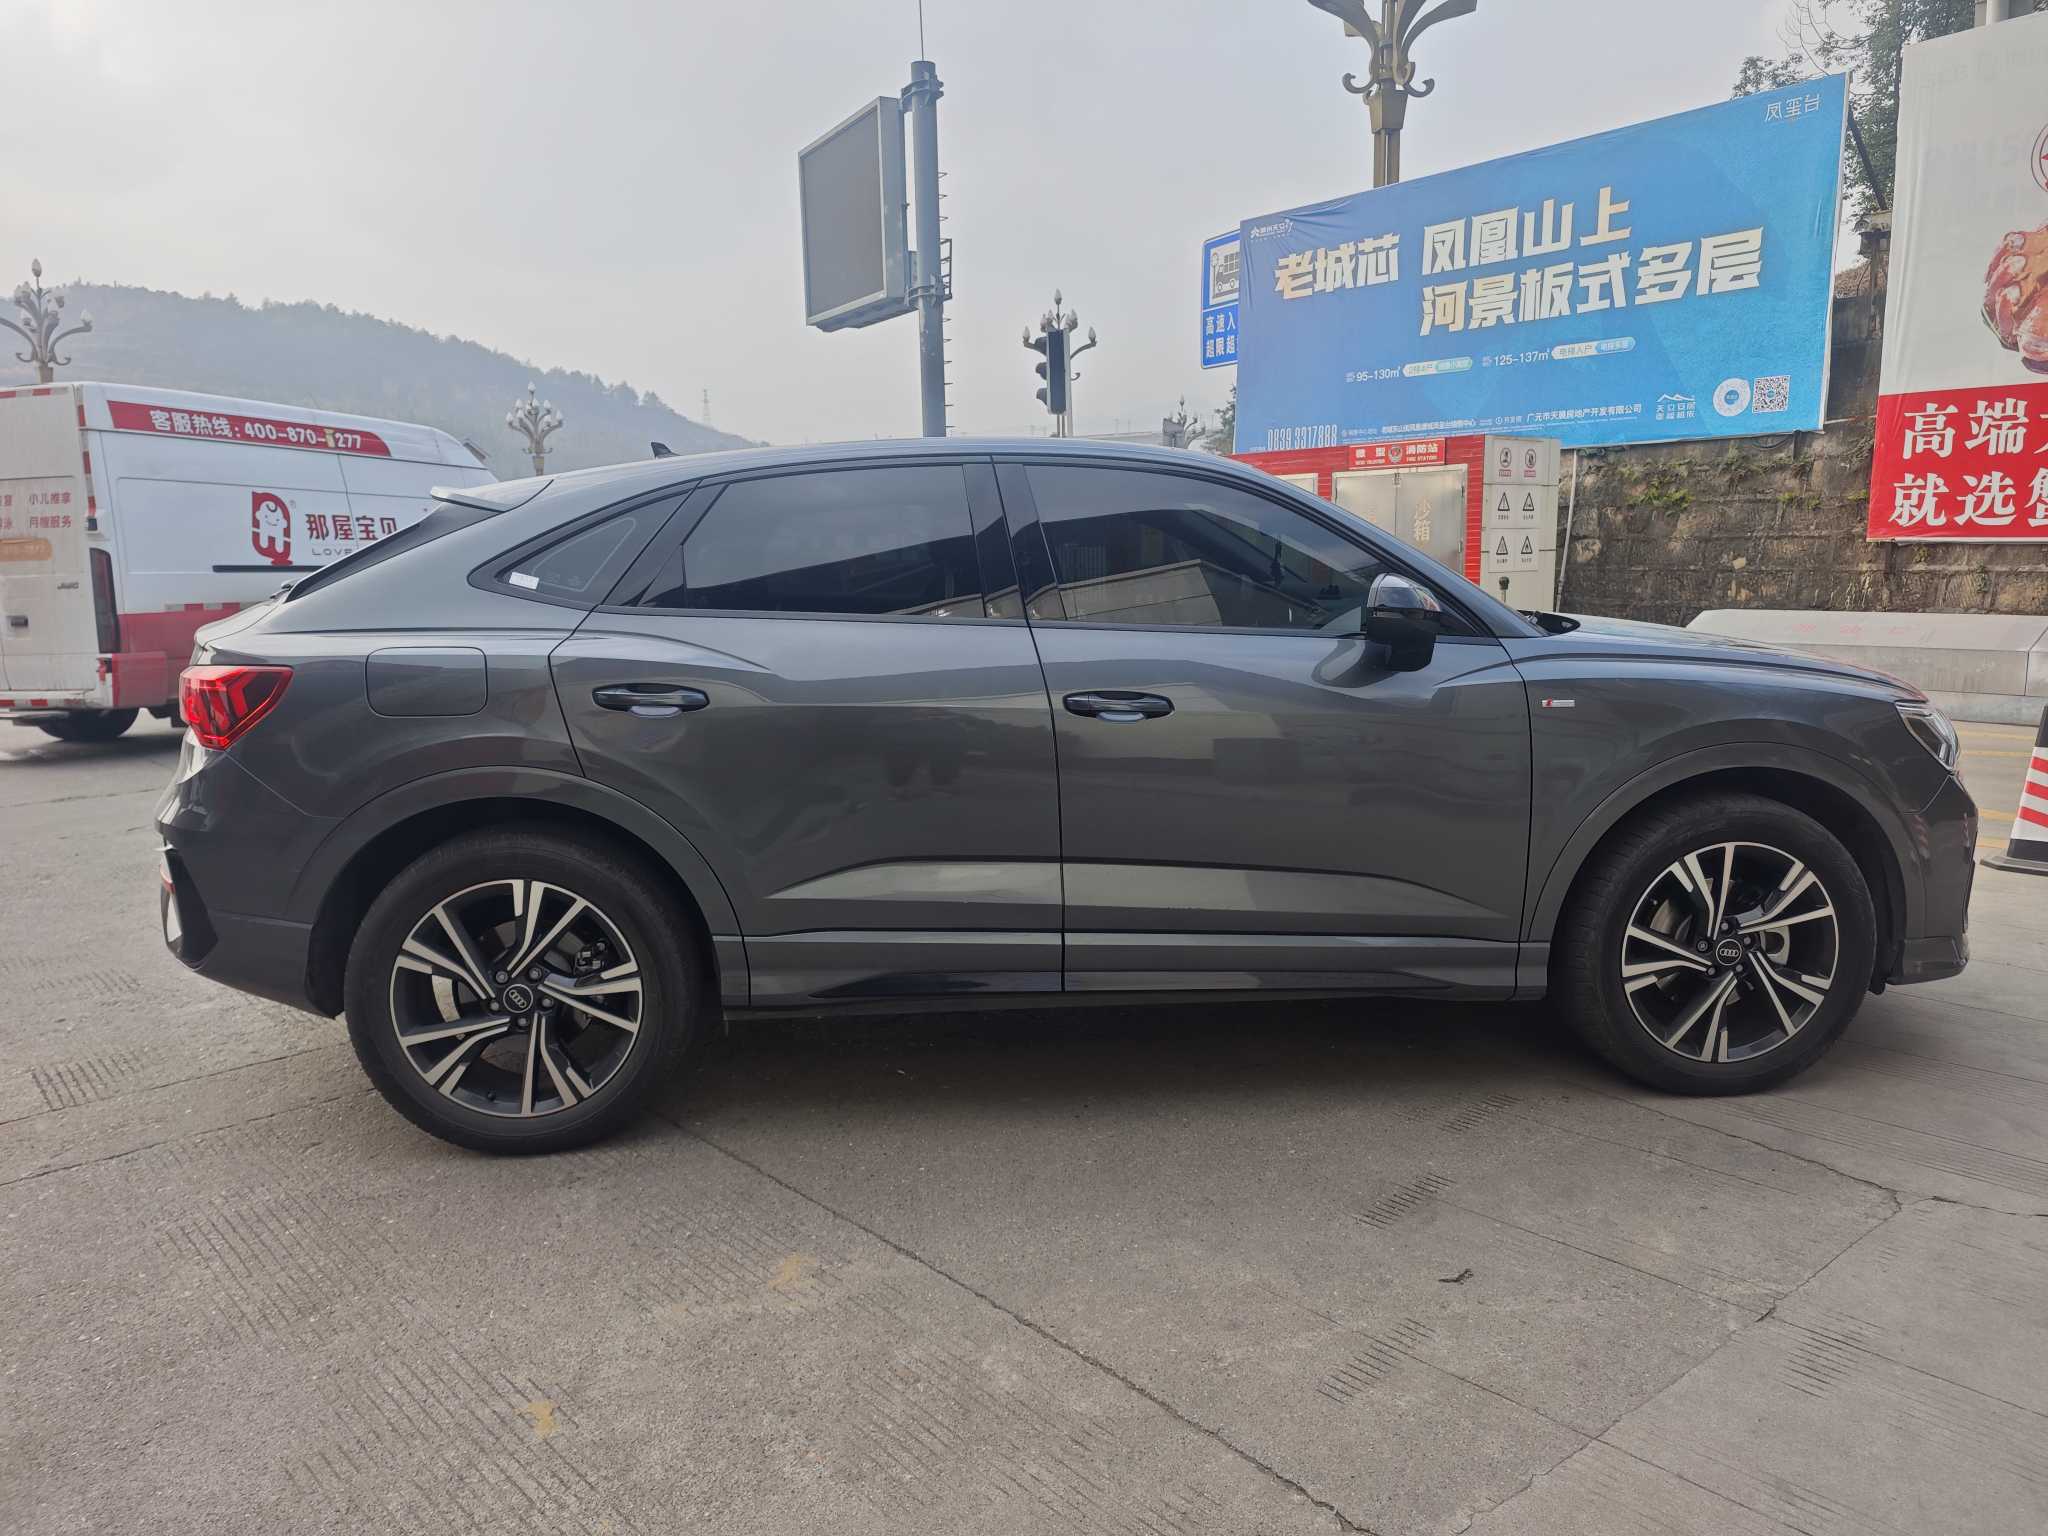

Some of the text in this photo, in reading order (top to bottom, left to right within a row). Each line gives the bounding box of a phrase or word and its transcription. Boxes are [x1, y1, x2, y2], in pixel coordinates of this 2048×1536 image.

[1274, 185, 1632, 299] 老城芯 凤凰山上
[1419, 226, 1764, 337] 河景板式多层
[1206, 335, 1239, 358] 超限超
[1902, 397, 2048, 460] 高端
[305, 513, 397, 541] 那屋宝贝
